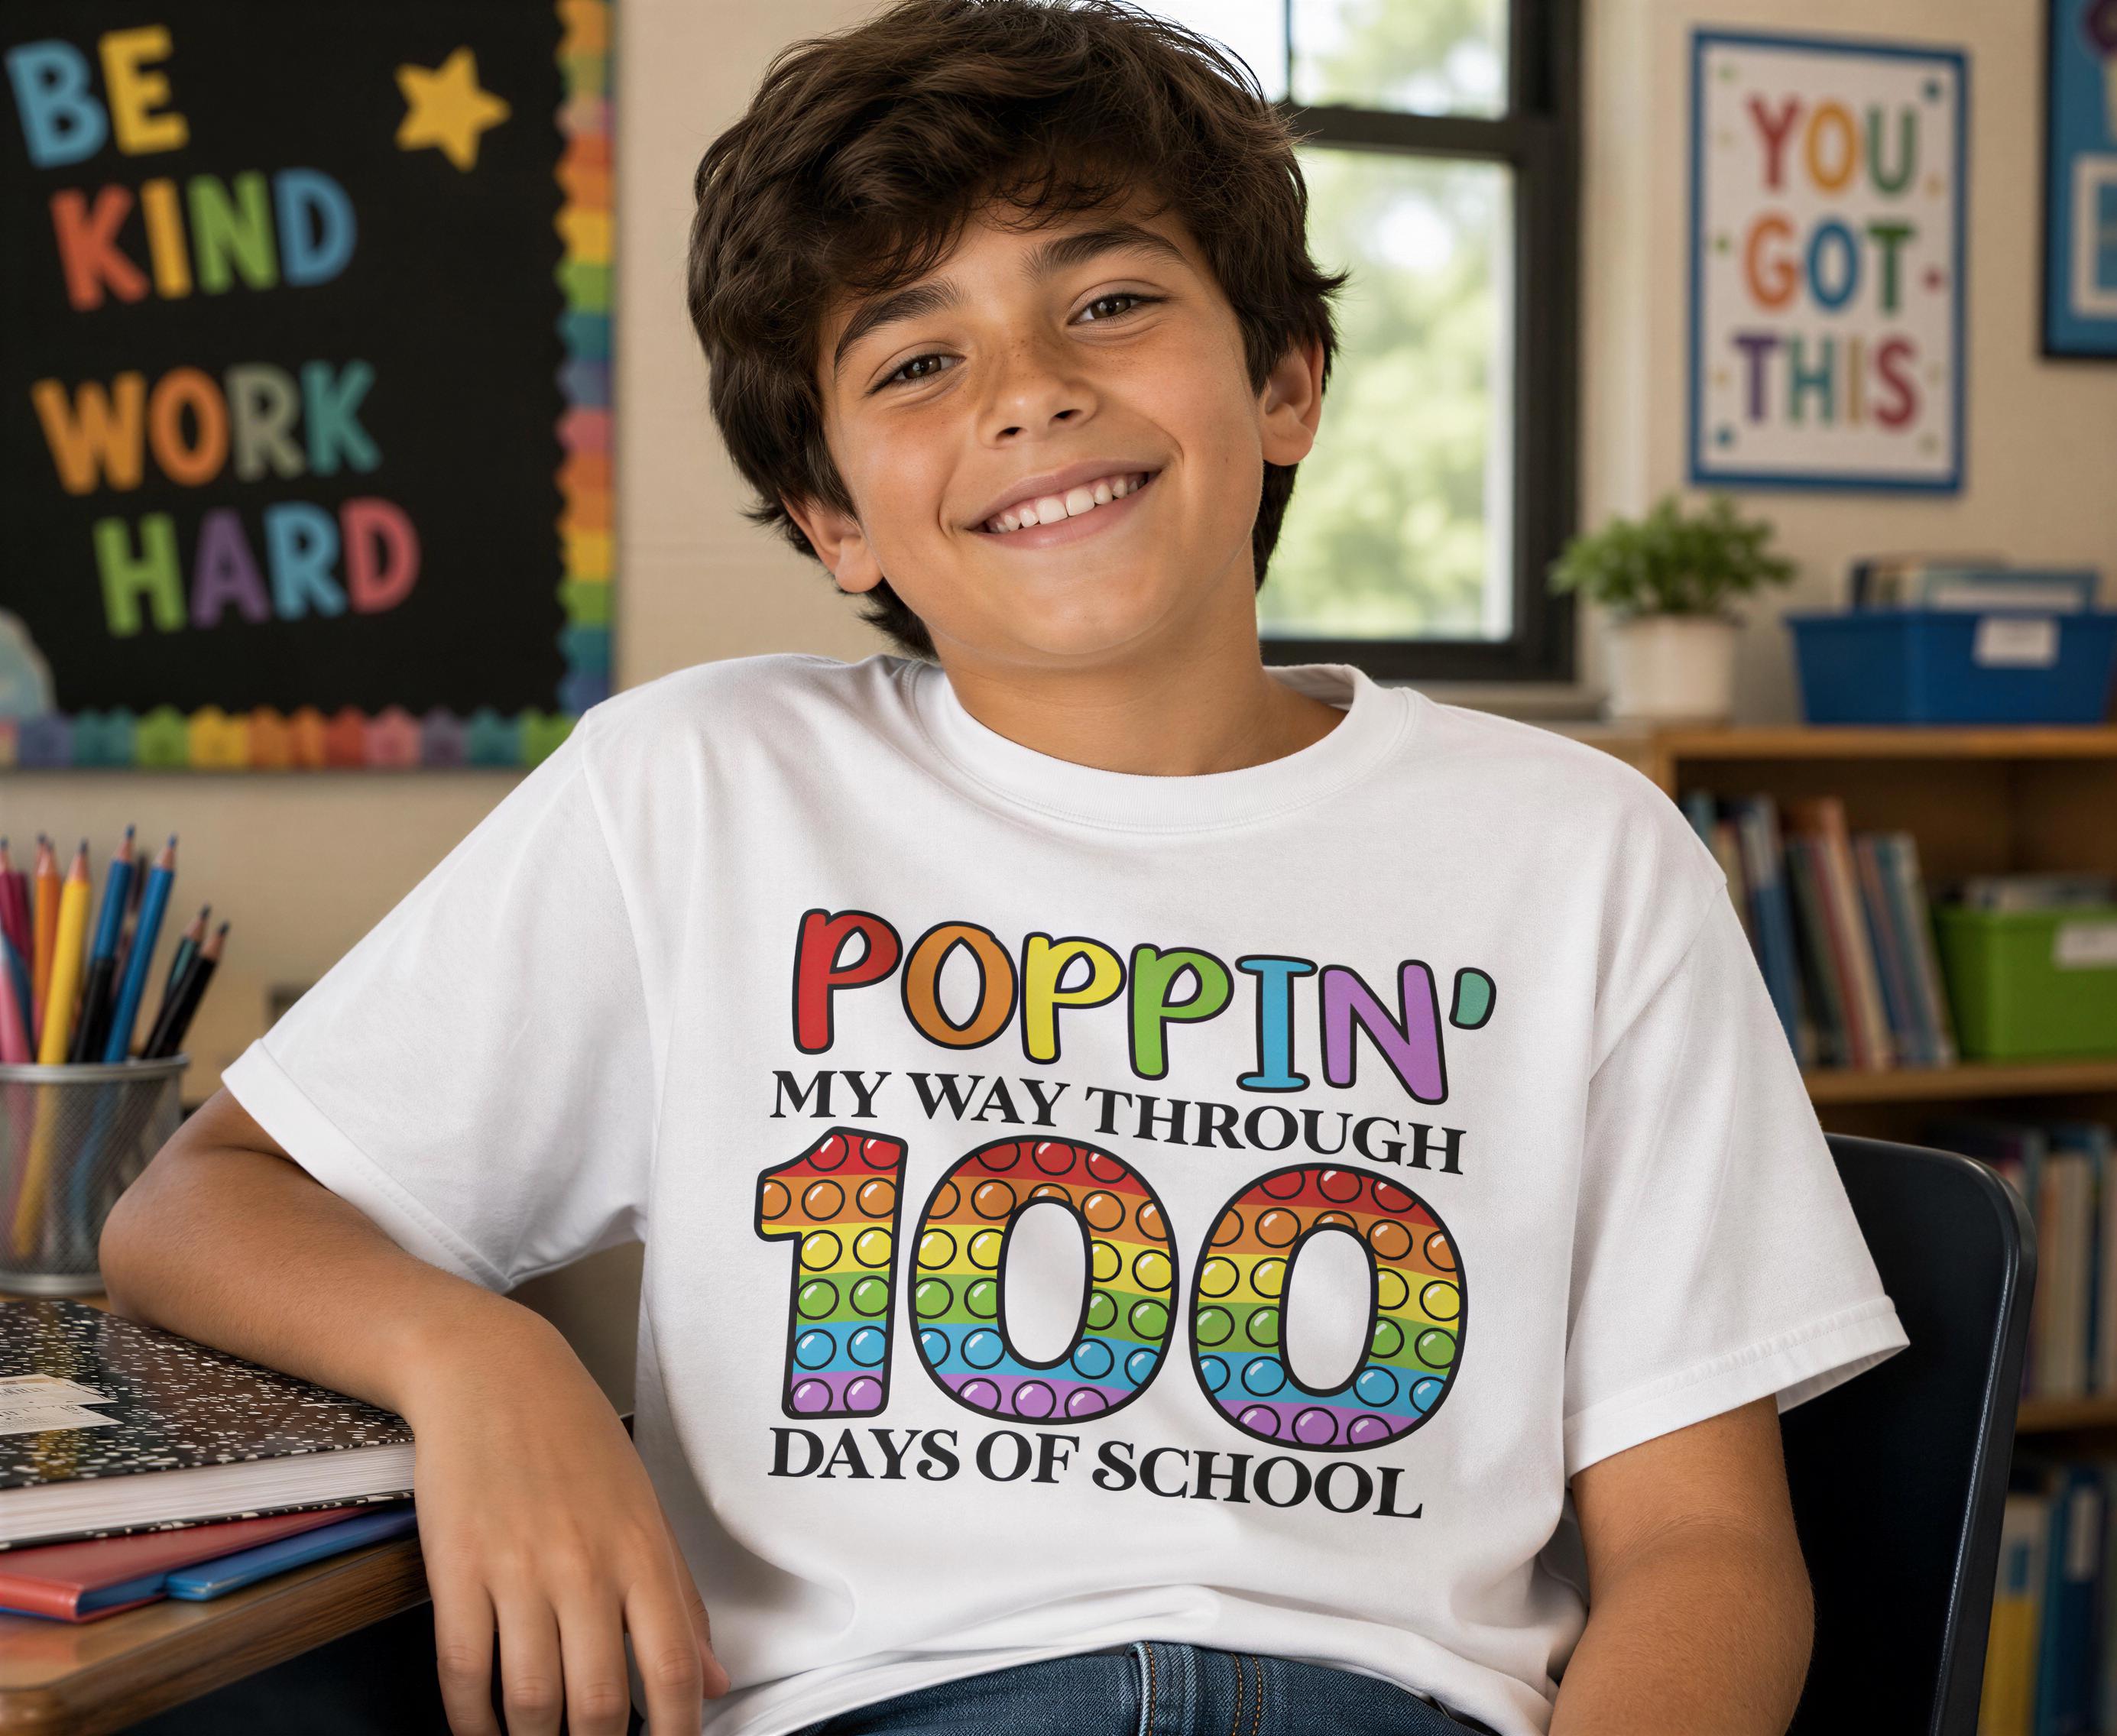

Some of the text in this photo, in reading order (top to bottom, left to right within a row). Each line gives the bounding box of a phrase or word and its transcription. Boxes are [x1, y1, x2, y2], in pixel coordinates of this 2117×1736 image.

[6, 25, 189, 167] BE
[1746, 95, 1921, 199] YOU
[50, 168, 358, 311] KIND
[1743, 212, 1919, 318] GOT
[32, 360, 382, 496] WORK
[1733, 332, 1921, 433] THIS
[93, 497, 421, 637] HARD
[793, 908, 1496, 1105] POPPIN'
[770, 1070, 1467, 1175] MY WAY THROUGH
[754, 1126, 1469, 1453] 100
[768, 1427, 1423, 1519] DAYS OF SCHOOL
